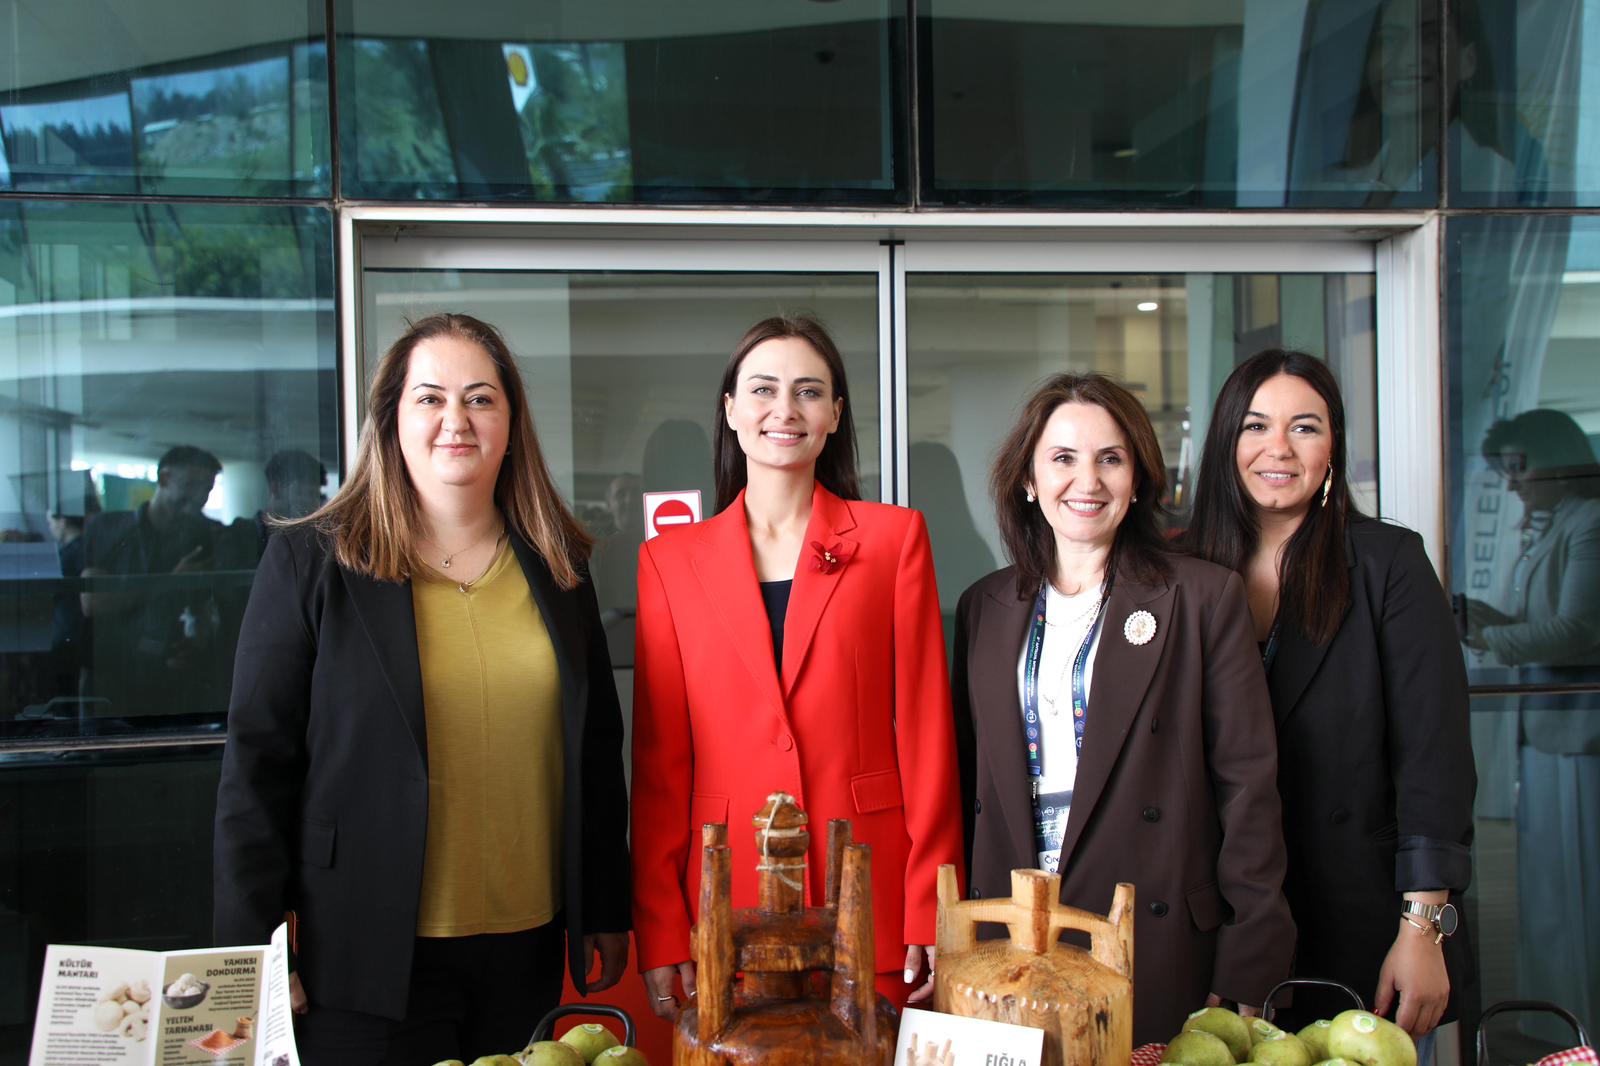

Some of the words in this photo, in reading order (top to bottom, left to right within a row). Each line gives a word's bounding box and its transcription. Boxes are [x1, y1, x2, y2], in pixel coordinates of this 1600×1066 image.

[59, 958, 93, 968] KÜLTÜR
[57, 970, 98, 979] MANTARI
[206, 967, 256, 977] DONDURMA
